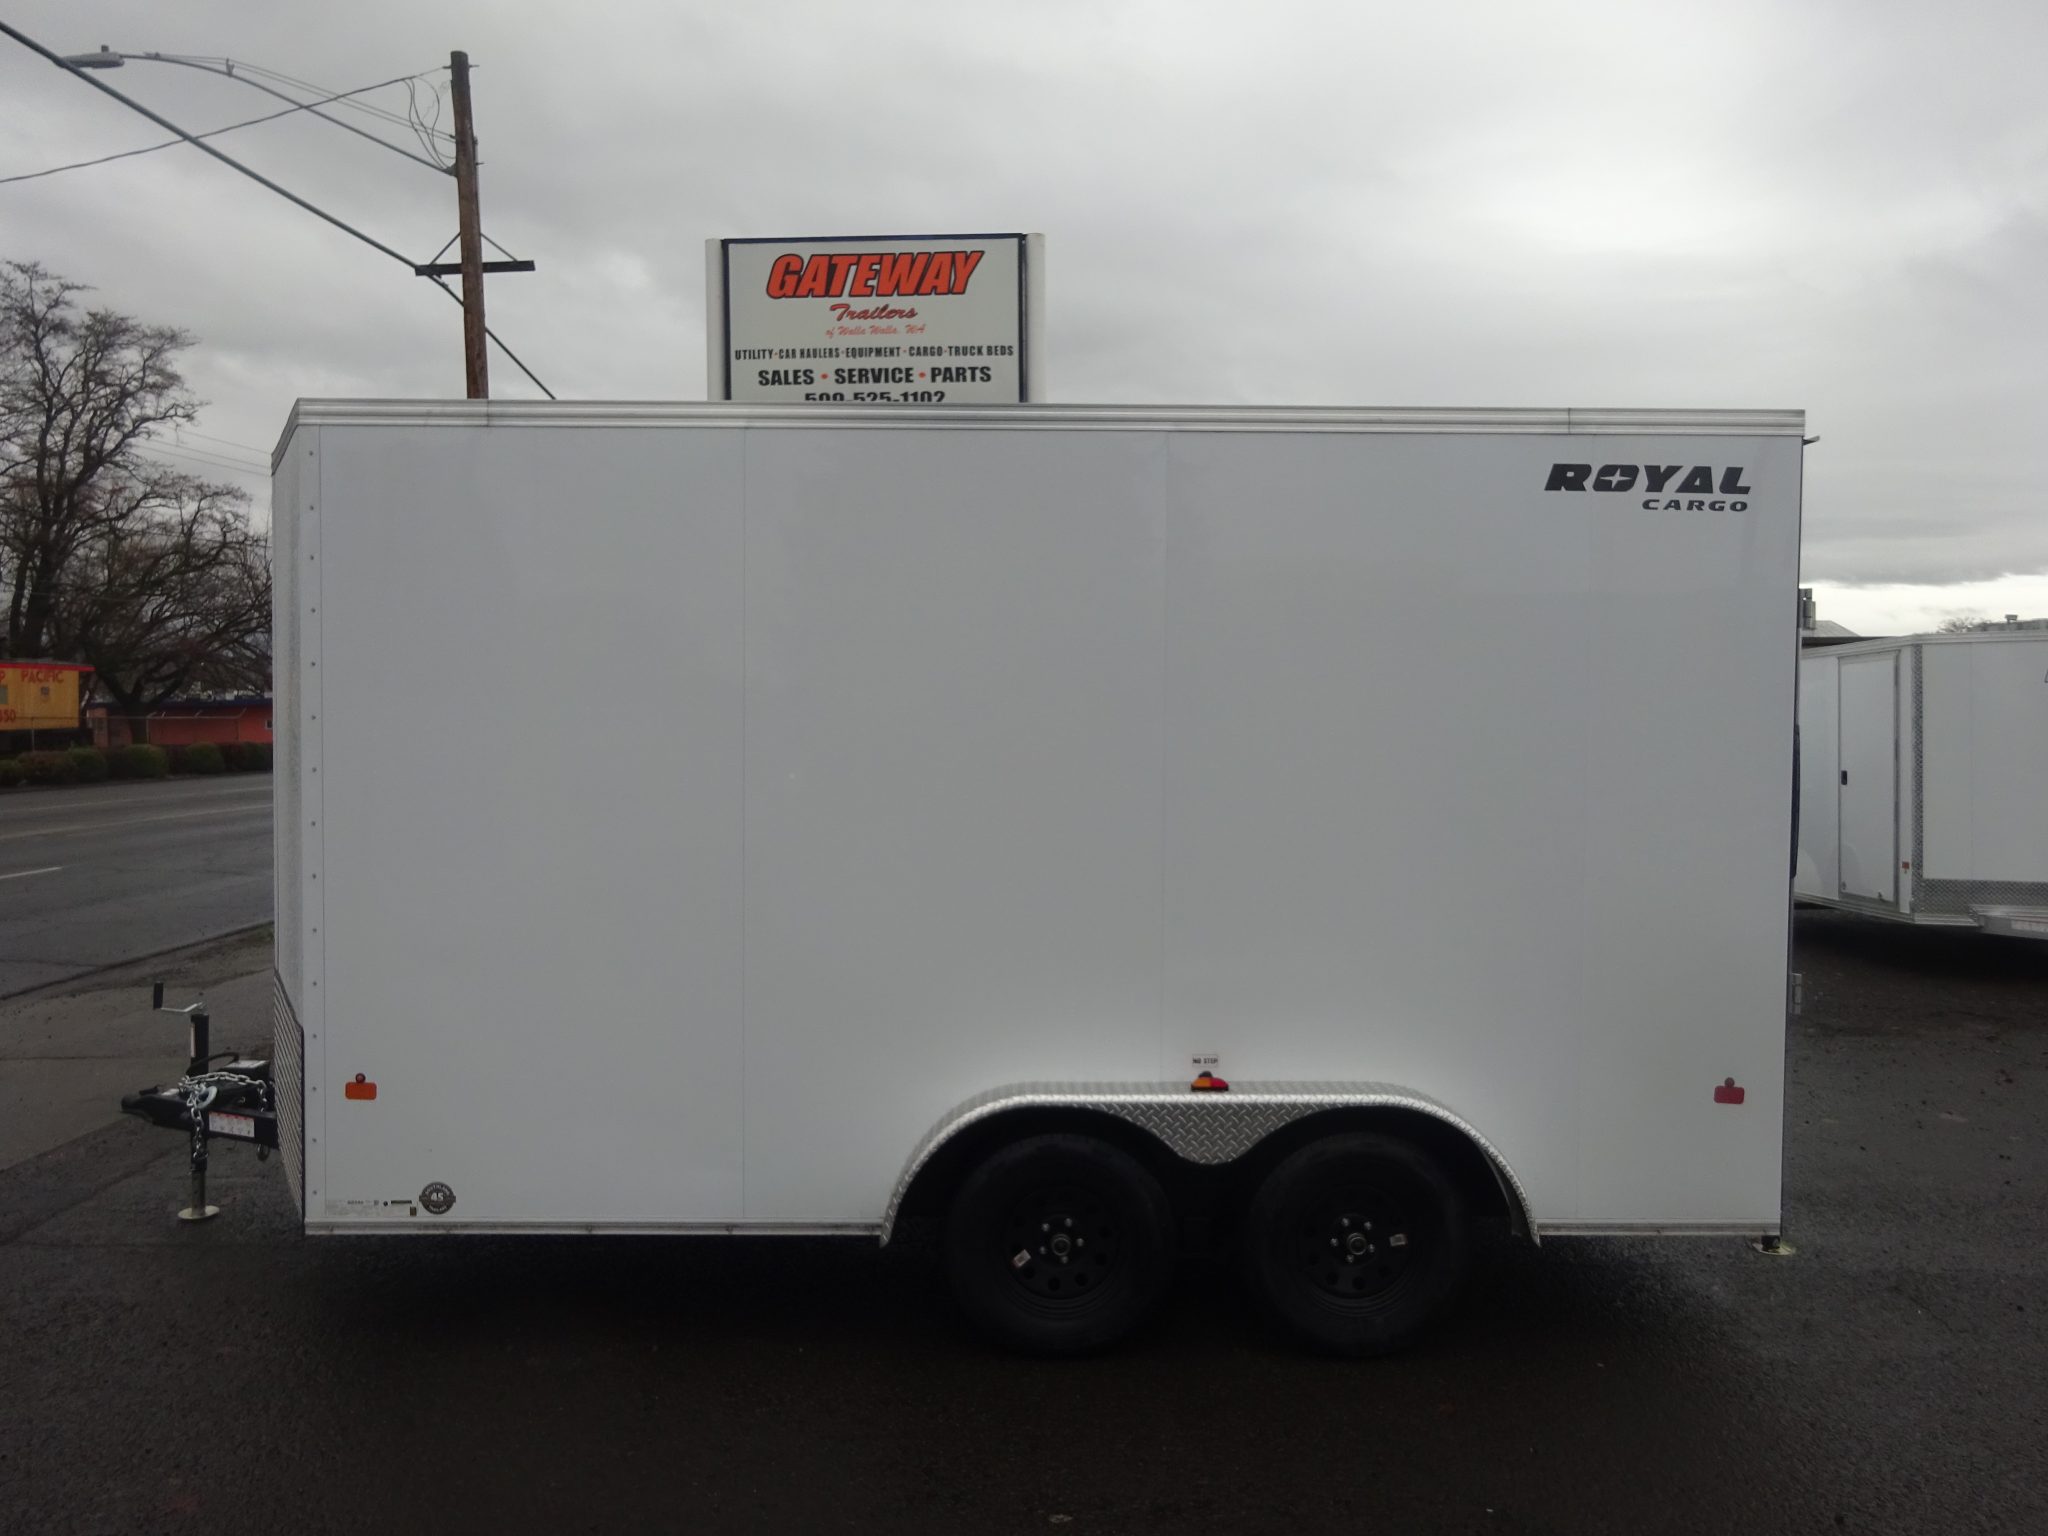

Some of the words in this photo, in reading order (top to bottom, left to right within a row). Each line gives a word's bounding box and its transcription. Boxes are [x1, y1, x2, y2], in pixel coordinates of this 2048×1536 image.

[766, 250, 985, 299] GATEWAY
[829, 303, 918, 321] Trailers
[735, 349, 774, 361] UTILITY
[778, 348, 797, 360] CAR
[799, 347, 840, 359] HAULERS
[845, 346, 901, 359] EQUIPMENT
[908, 345, 944, 357] CARGO
[947, 345, 984, 357] TRUCK
[986, 345, 1014, 357] BEDS
[758, 369, 815, 386] SALES
[834, 366, 915, 384] SERVICE
[930, 366, 992, 383] PARTS
[1544, 463, 1751, 495] ROYAL
[1642, 499, 1748, 512] CARGO
[430, 1192, 444, 1201] 45
